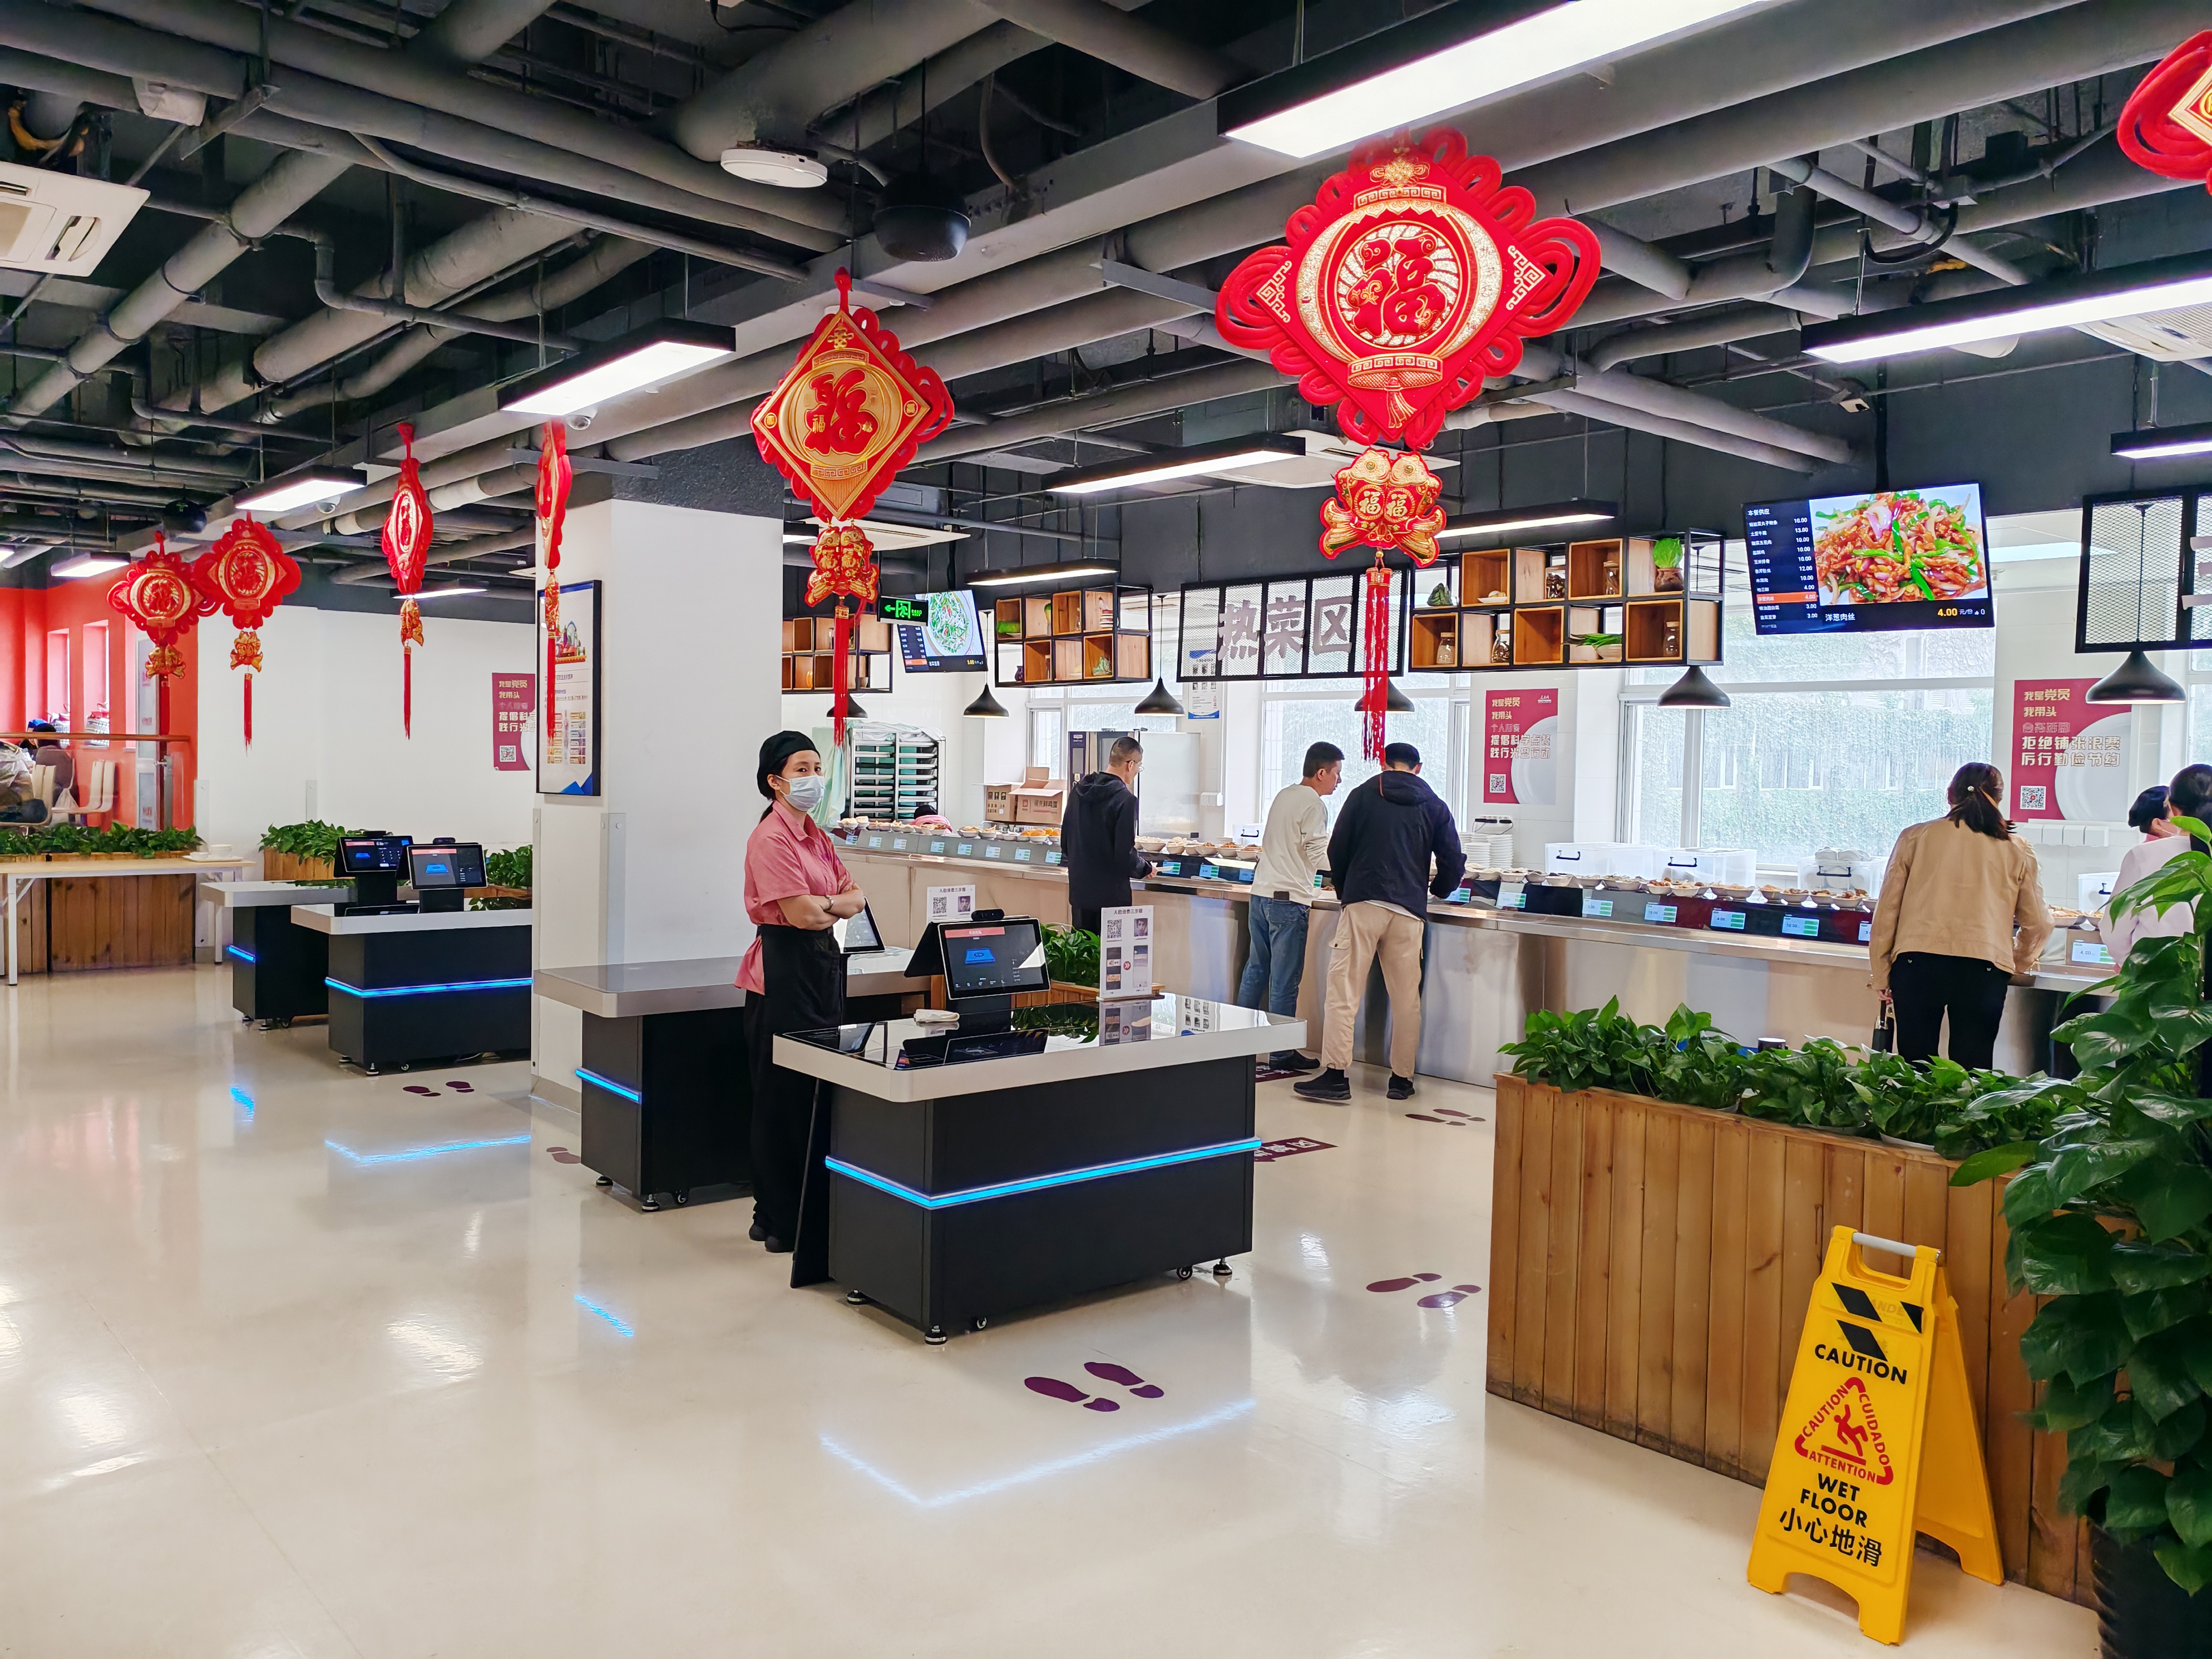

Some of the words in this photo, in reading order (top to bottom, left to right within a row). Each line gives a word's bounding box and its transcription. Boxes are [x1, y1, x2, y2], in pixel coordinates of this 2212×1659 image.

[1359, 491, 1381, 514] 福
[1386, 494, 1407, 517] 福
[1825, 613, 1856, 622] 洋葱肉丝
[1938, 608, 1958, 617] 4.00
[1218, 595, 1353, 661] 热菜区
[1492, 697, 1520, 707] 我是党员
[2024, 689, 2071, 701] 我是党员
[1492, 711, 1512, 720] 我带头
[2024, 706, 2057, 717] 我带头
[1491, 734, 1550, 746] 提倡科学点餐
[2022, 736, 2121, 751] 拒绝铺张浪费
[1490, 747, 1550, 759] 践行光盘行动
[2021, 752, 2120, 767] 厉行勤俭节约
[1815, 1344, 1907, 1385] CAUTION
[1802, 1384, 1849, 1438] CAUTION
[1859, 1394, 1891, 1466] CUIDADO
[1809, 1450, 1877, 1482] ATTENTION
[1818, 1473, 1860, 1503] WET
[1800, 1489, 1867, 1528] FLOOR
[1779, 1507, 1882, 1567] 小心地滑
